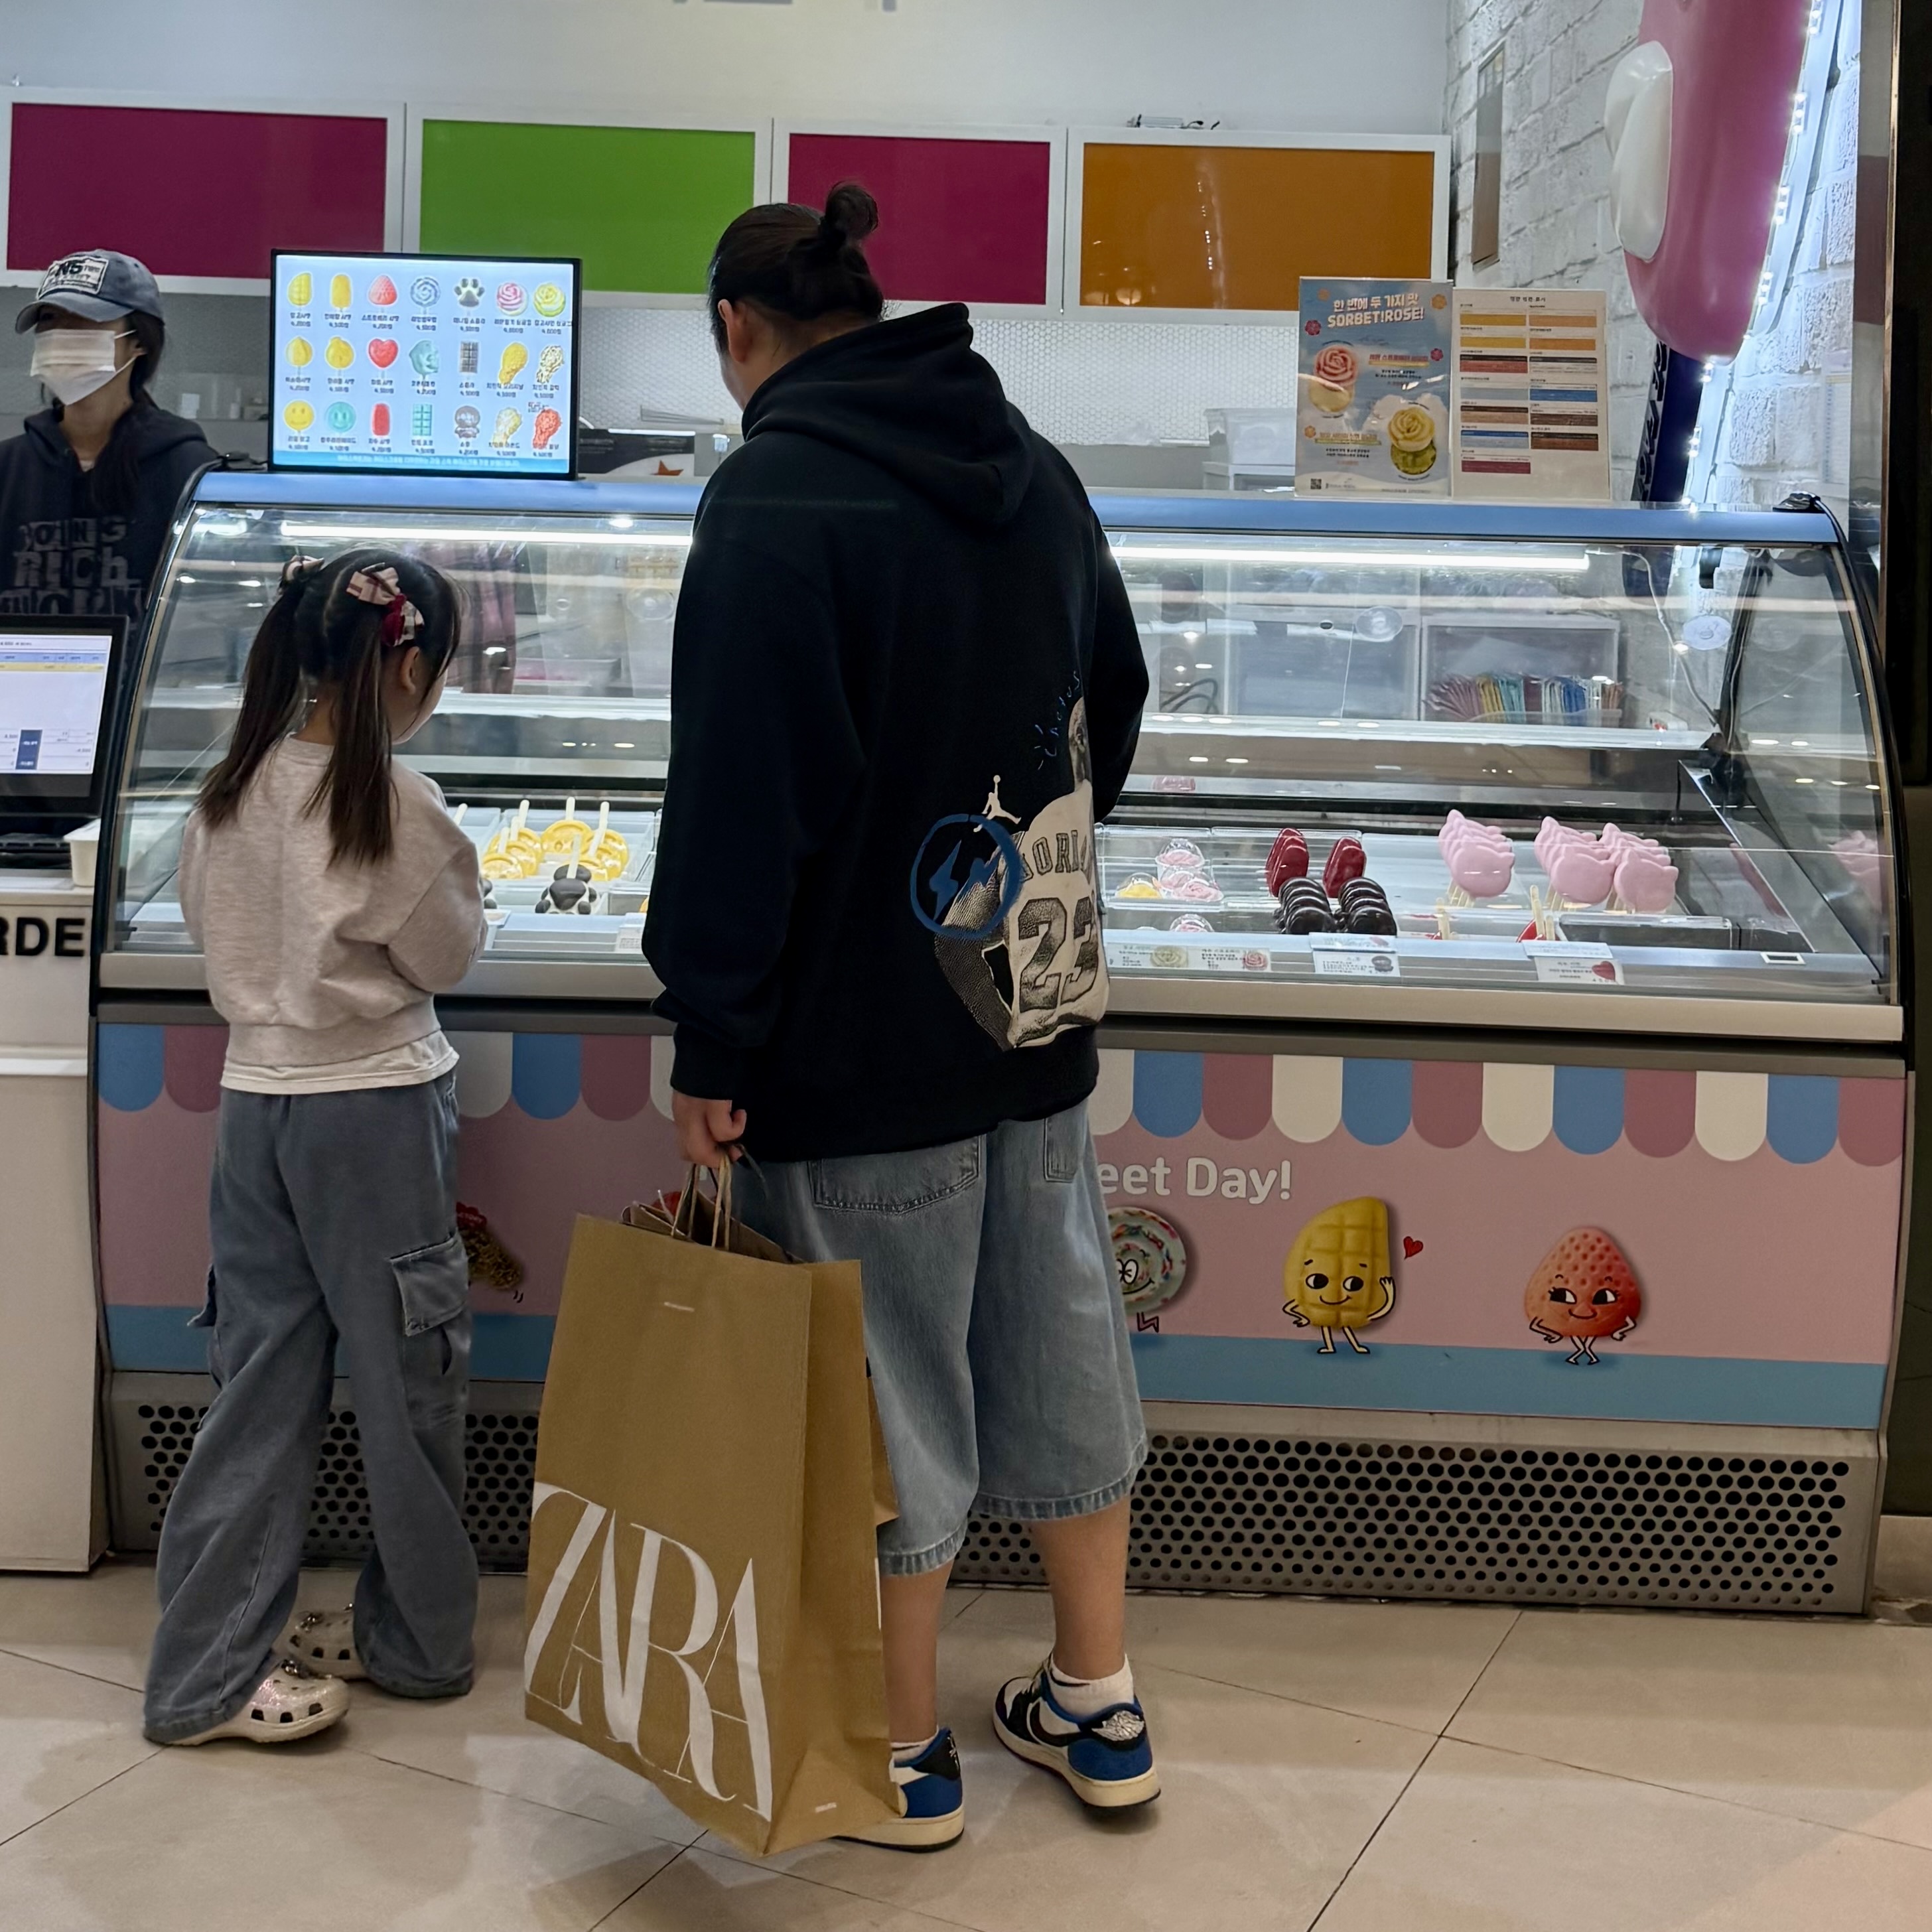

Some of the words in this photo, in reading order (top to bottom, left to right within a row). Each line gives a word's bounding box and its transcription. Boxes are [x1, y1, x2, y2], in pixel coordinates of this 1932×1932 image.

[1327, 307, 1424, 328] SORBET!ROSE!
[1334, 299, 1345, 312] 한
[1347, 297, 1368, 311] 번에
[1370, 296, 1382, 309] 두
[1384, 293, 1405, 308] 가지
[1406, 292, 1419, 307] 맛
[1186, 1156, 1291, 1205] Day!
[524, 1482, 774, 1823] ZARA
